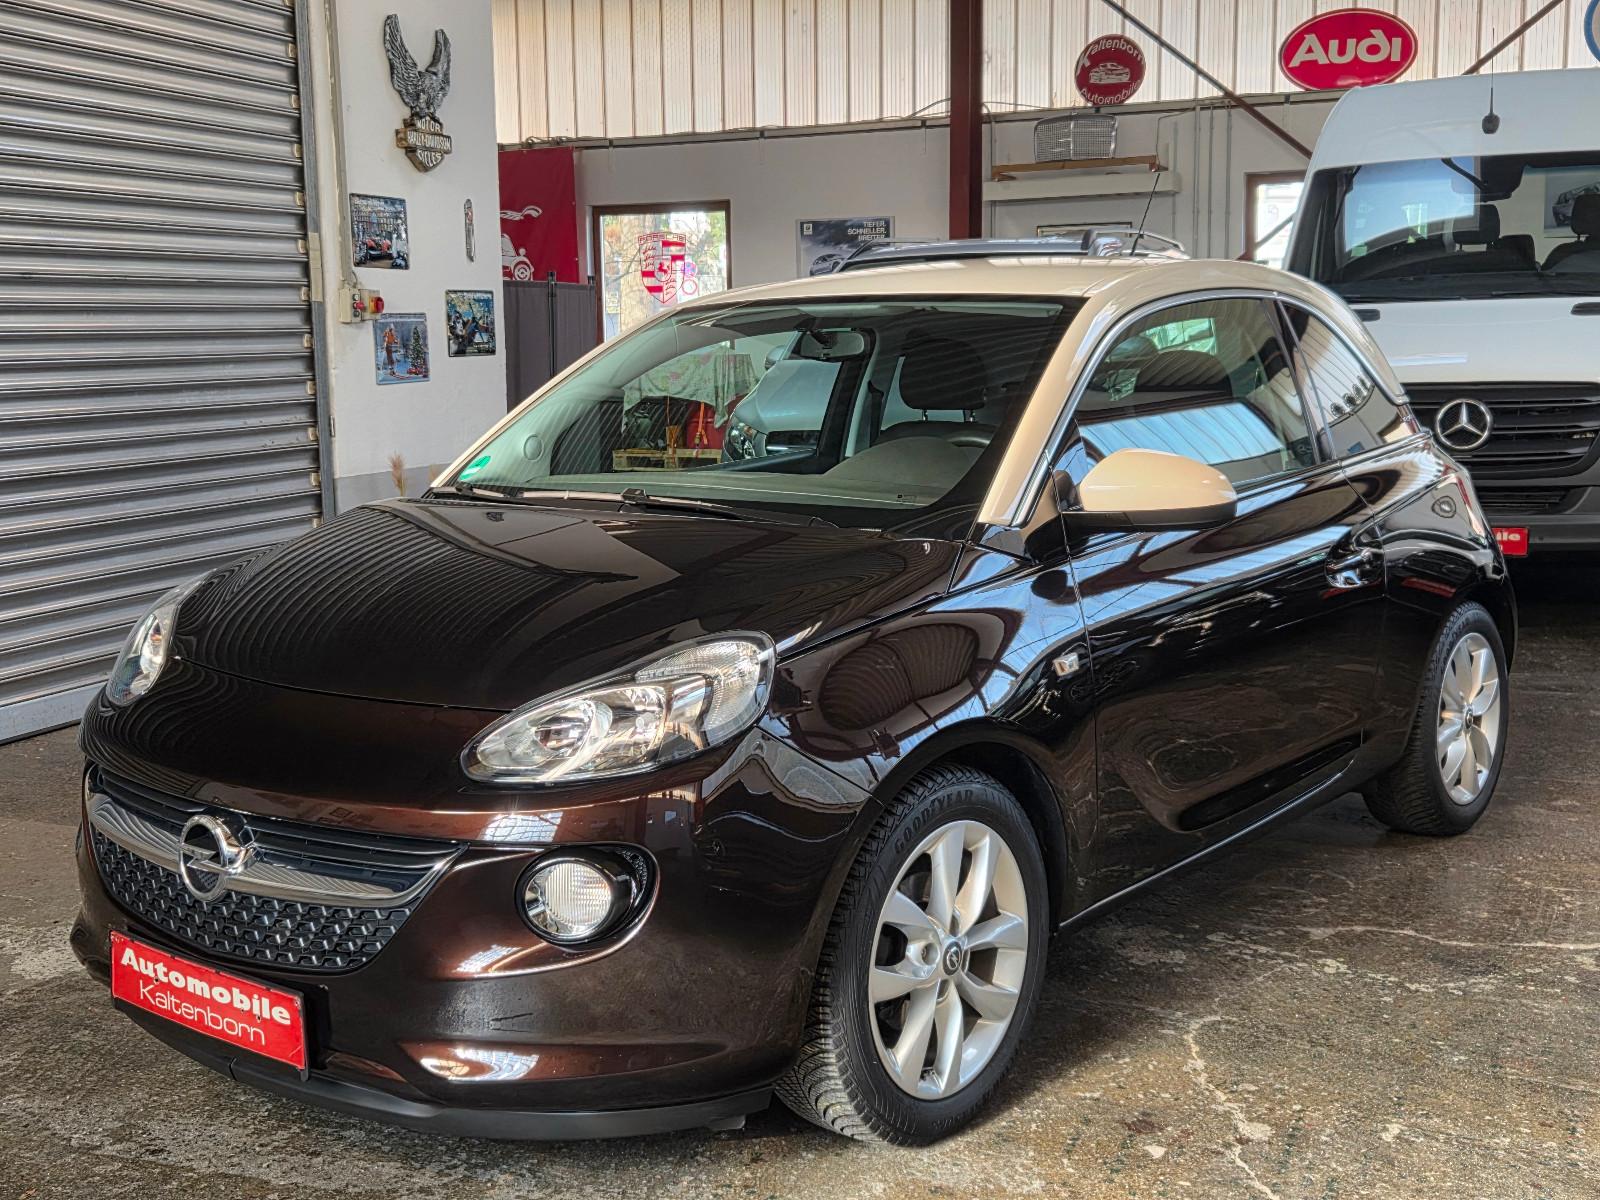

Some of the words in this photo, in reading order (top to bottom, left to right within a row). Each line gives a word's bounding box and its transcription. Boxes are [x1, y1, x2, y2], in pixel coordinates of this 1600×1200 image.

[1076, 39, 1145, 76] Kaltenborn
[1288, 29, 1402, 67] Audi
[416, 117, 441, 132] MOTOR
[417, 150, 442, 167] CYCLES
[895, 789, 973, 854] GOODYEAR
[121, 948, 291, 1025] Automobile
[140, 980, 266, 1045] Kaltenborn
